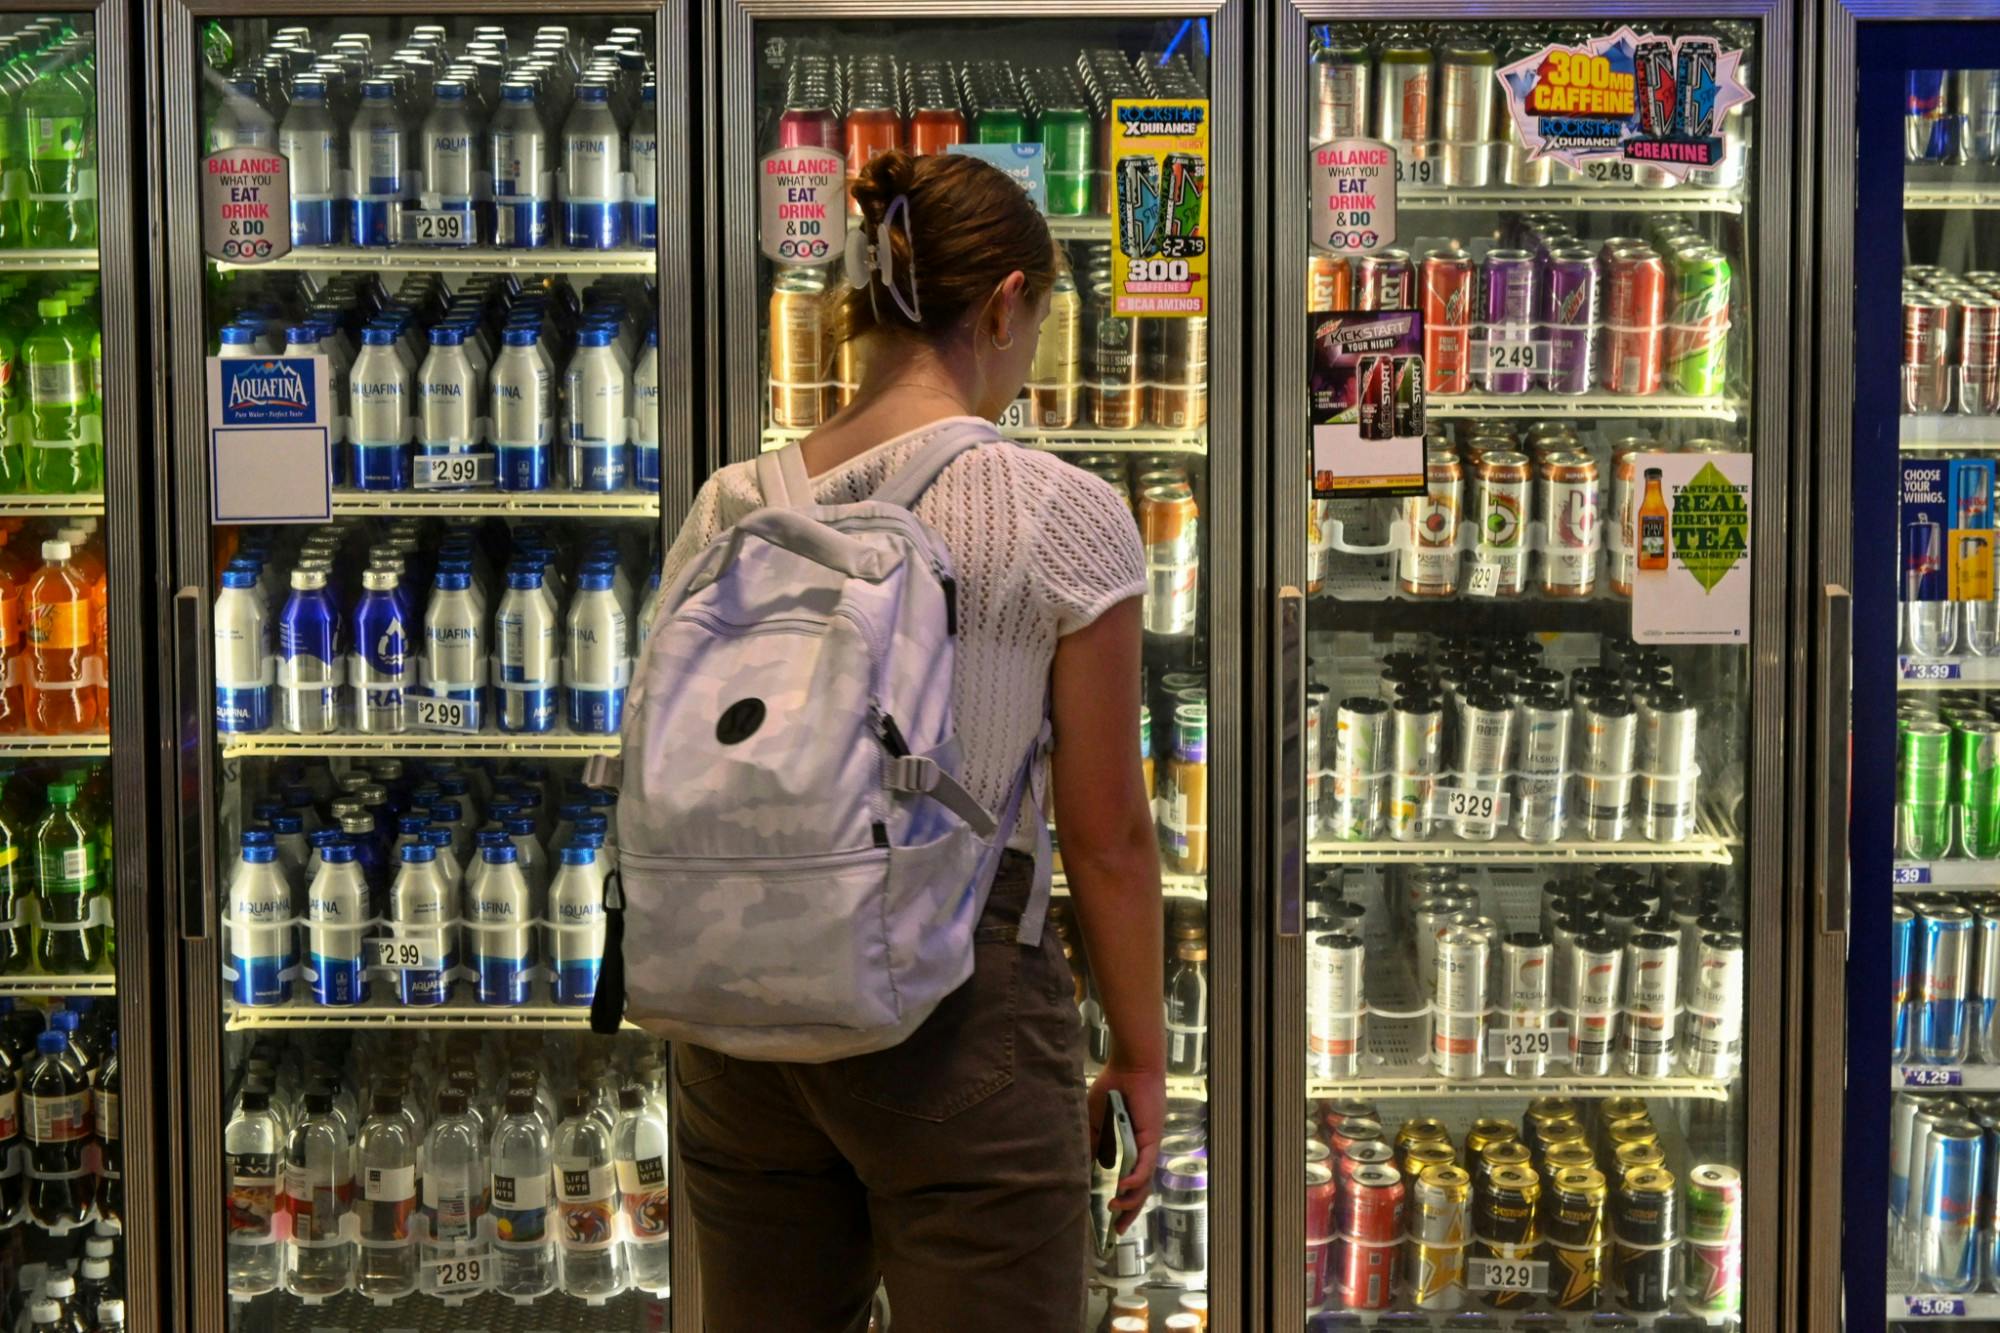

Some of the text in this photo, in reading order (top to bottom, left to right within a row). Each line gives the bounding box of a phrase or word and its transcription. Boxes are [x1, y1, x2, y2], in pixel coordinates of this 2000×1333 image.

[1535, 85, 1635, 114] CAFFEINE
[208, 158, 281, 174] BALANCE
[1317, 150, 1389, 166] BALANCE
[766, 159, 837, 175] BALANCE
[1328, 166, 1379, 177] WHAT YOU
[220, 175, 271, 186] WHAT YOU
[777, 175, 828, 186] WHAT YOU
[1329, 195, 1376, 210] DRINK
[221, 204, 270, 219] DRINK
[779, 204, 826, 219] DRINK
[1336, 211, 1370, 227] & DO
[229, 220, 264, 235] & DO
[416, 216, 459, 238] $2.99
[786, 220, 821, 236] & DO
[1163, 238, 1204, 256] $2.79
[1128, 259, 1189, 282] 300
[1135, 282, 1182, 292] CAFFEINE
[1157, 298, 1201, 311] AMINOS
[1348, 338, 1394, 352] YOUR NIGHT
[1490, 346, 1533, 368] $2.49
[228, 373, 308, 408] AQUAFINA
[431, 460, 476, 482] $2.99
[1904, 469, 1941, 481] CHOOSE
[1672, 485, 1748, 494] TASTES LIKE
[1904, 481, 1930, 492] YOUR
[1673, 494, 1747, 512] REAL
[1672, 514, 1747, 526] BREWED
[1672, 526, 1747, 550] TEA
[1672, 551, 1748, 559] BECAUSE IT IS
[419, 701, 461, 725] $2.99
[1450, 793, 1493, 817] $3.29
[379, 943, 420, 965] $2.99
[1506, 1033, 1549, 1055] $3.29
[436, 1260, 480, 1284] $2.89
[1486, 1265, 1530, 1287] $3.29
